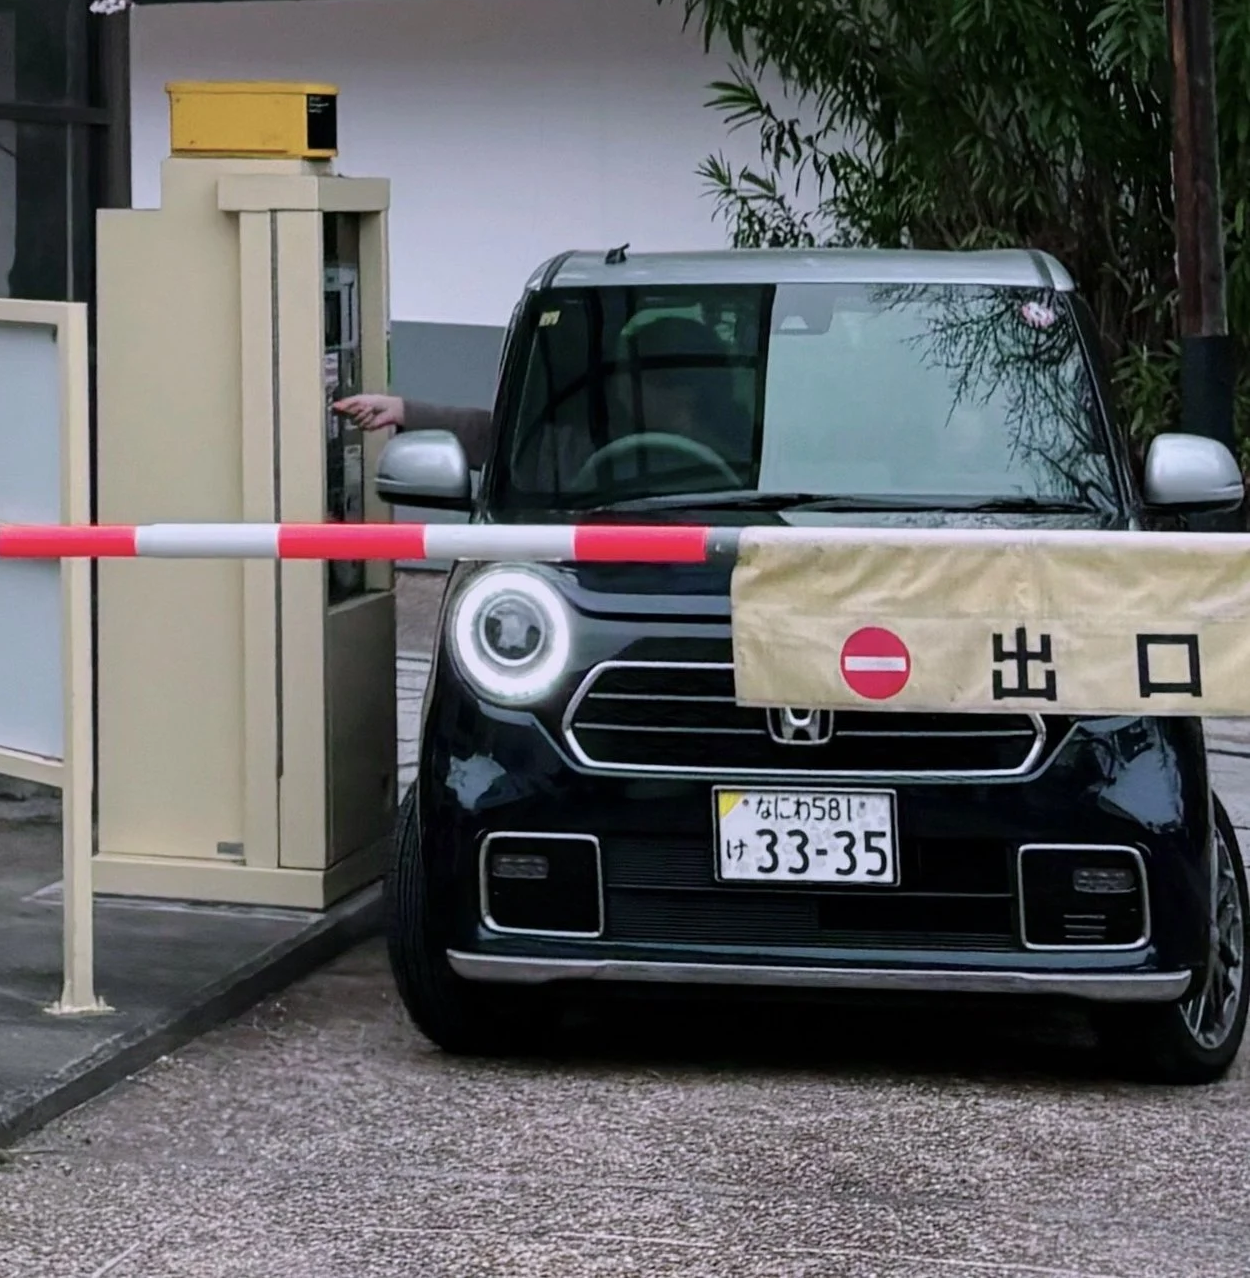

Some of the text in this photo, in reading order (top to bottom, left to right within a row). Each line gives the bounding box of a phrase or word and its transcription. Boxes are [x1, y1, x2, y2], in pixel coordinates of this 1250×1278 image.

[992, 626, 1203, 701] 出口
[726, 828, 888, 876] け 33-35
